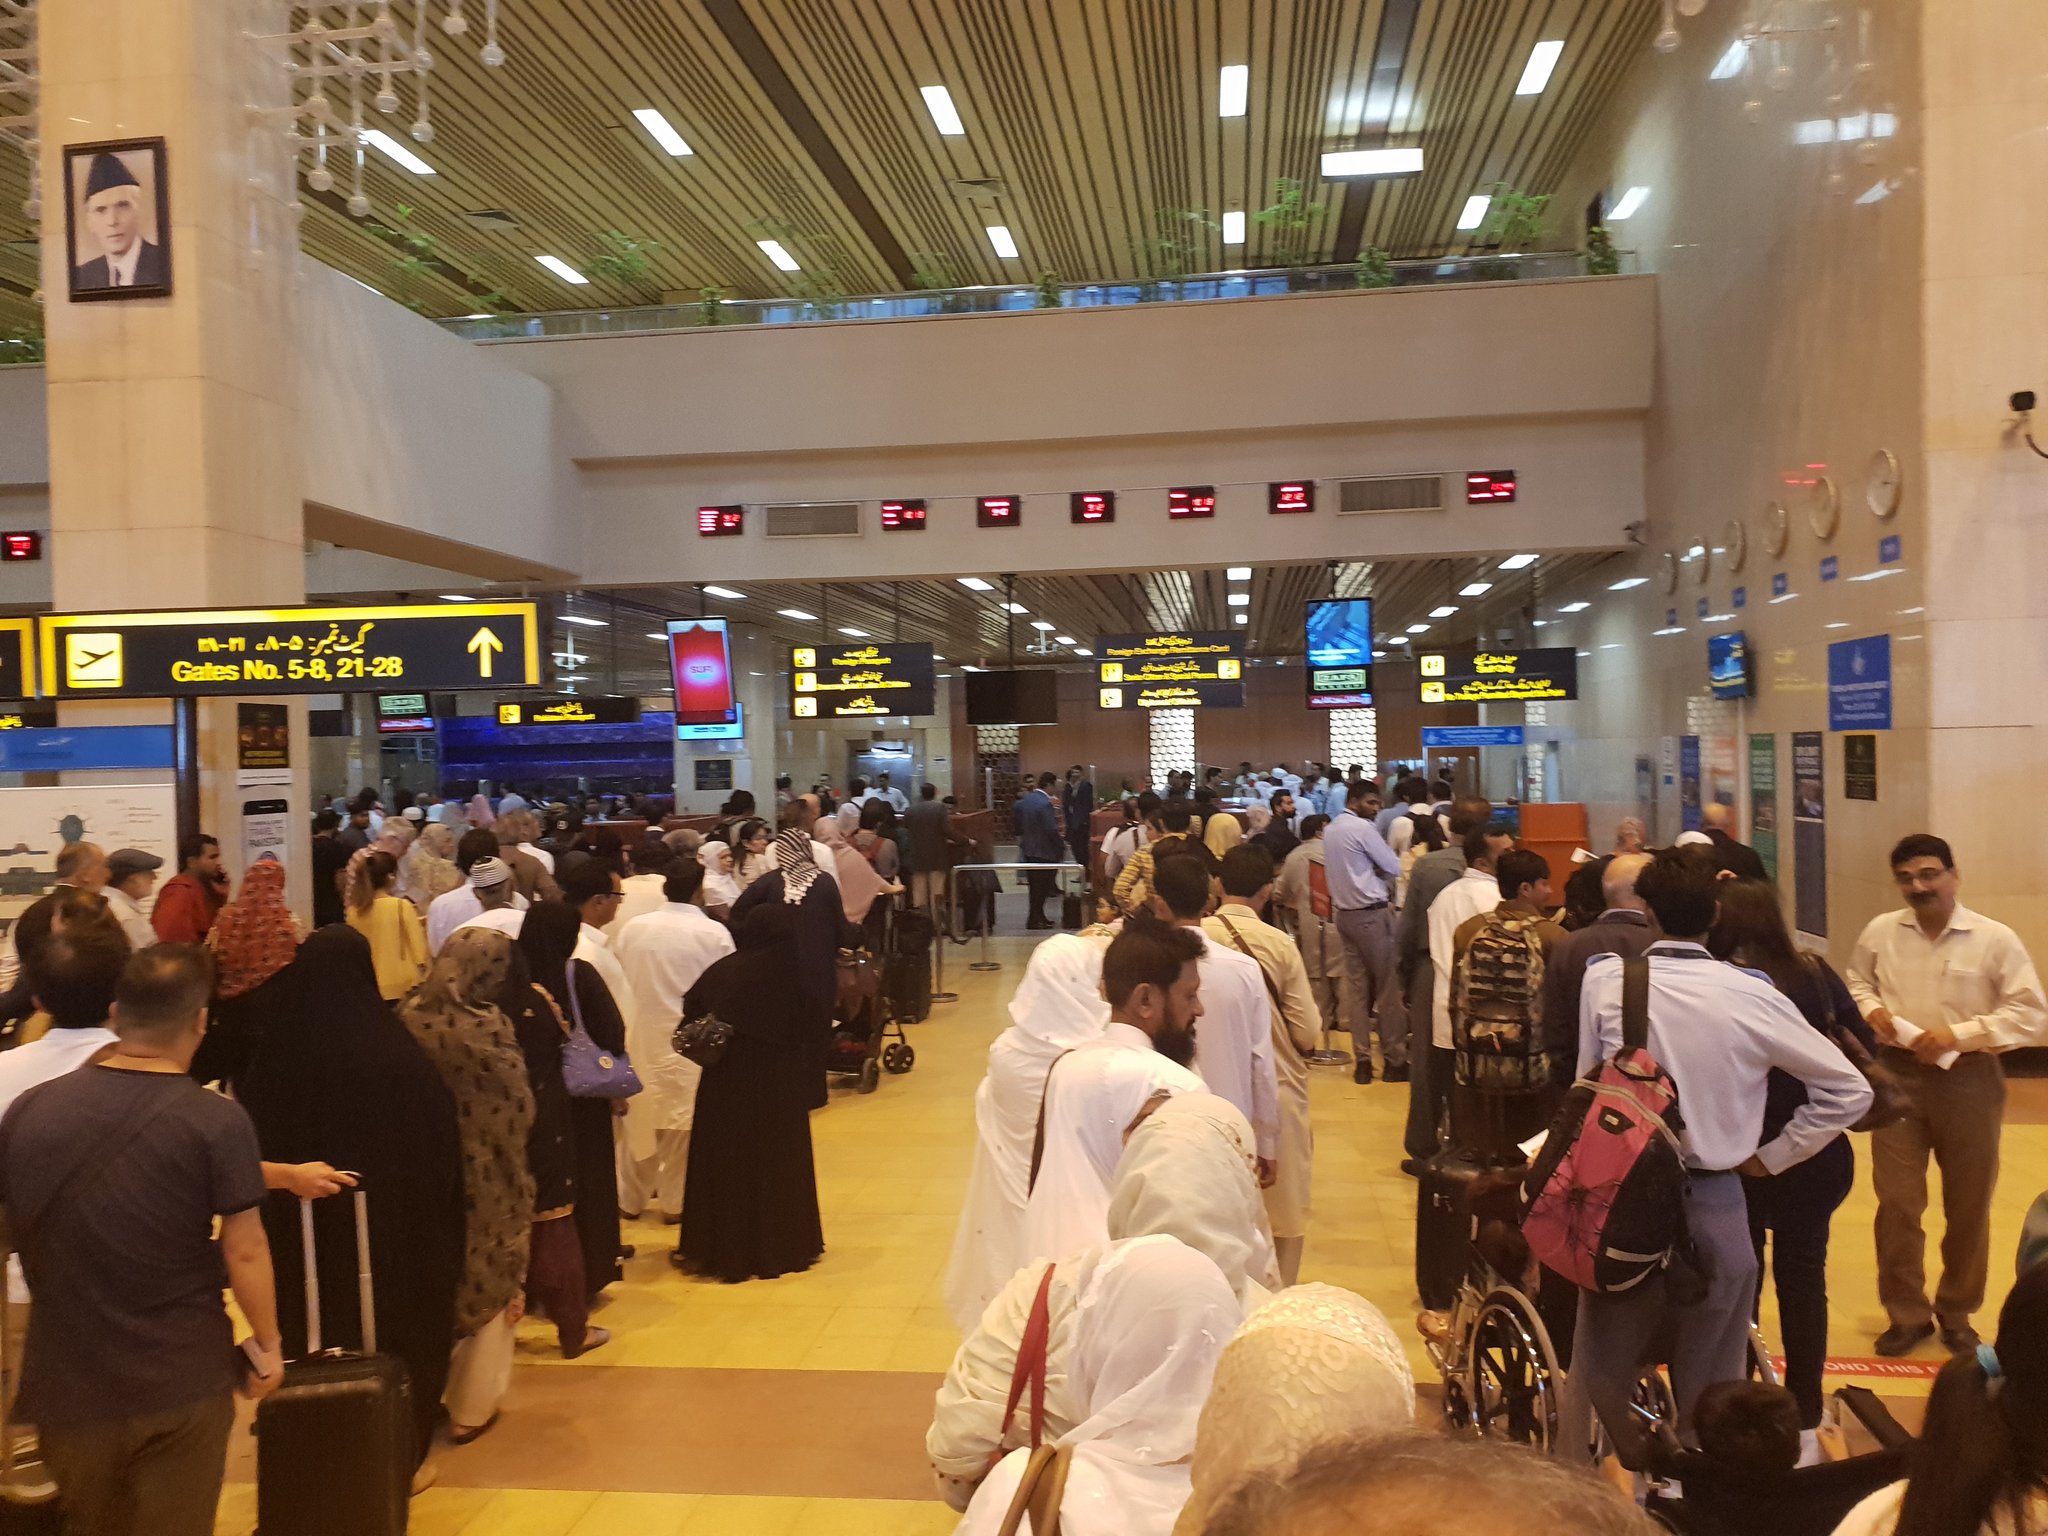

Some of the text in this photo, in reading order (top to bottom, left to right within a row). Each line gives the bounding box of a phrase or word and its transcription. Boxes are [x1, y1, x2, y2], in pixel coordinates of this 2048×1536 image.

[171, 656, 403, 682] Gates No. 5-8, 21-28
[1872, 1363, 1924, 1374] THIS
